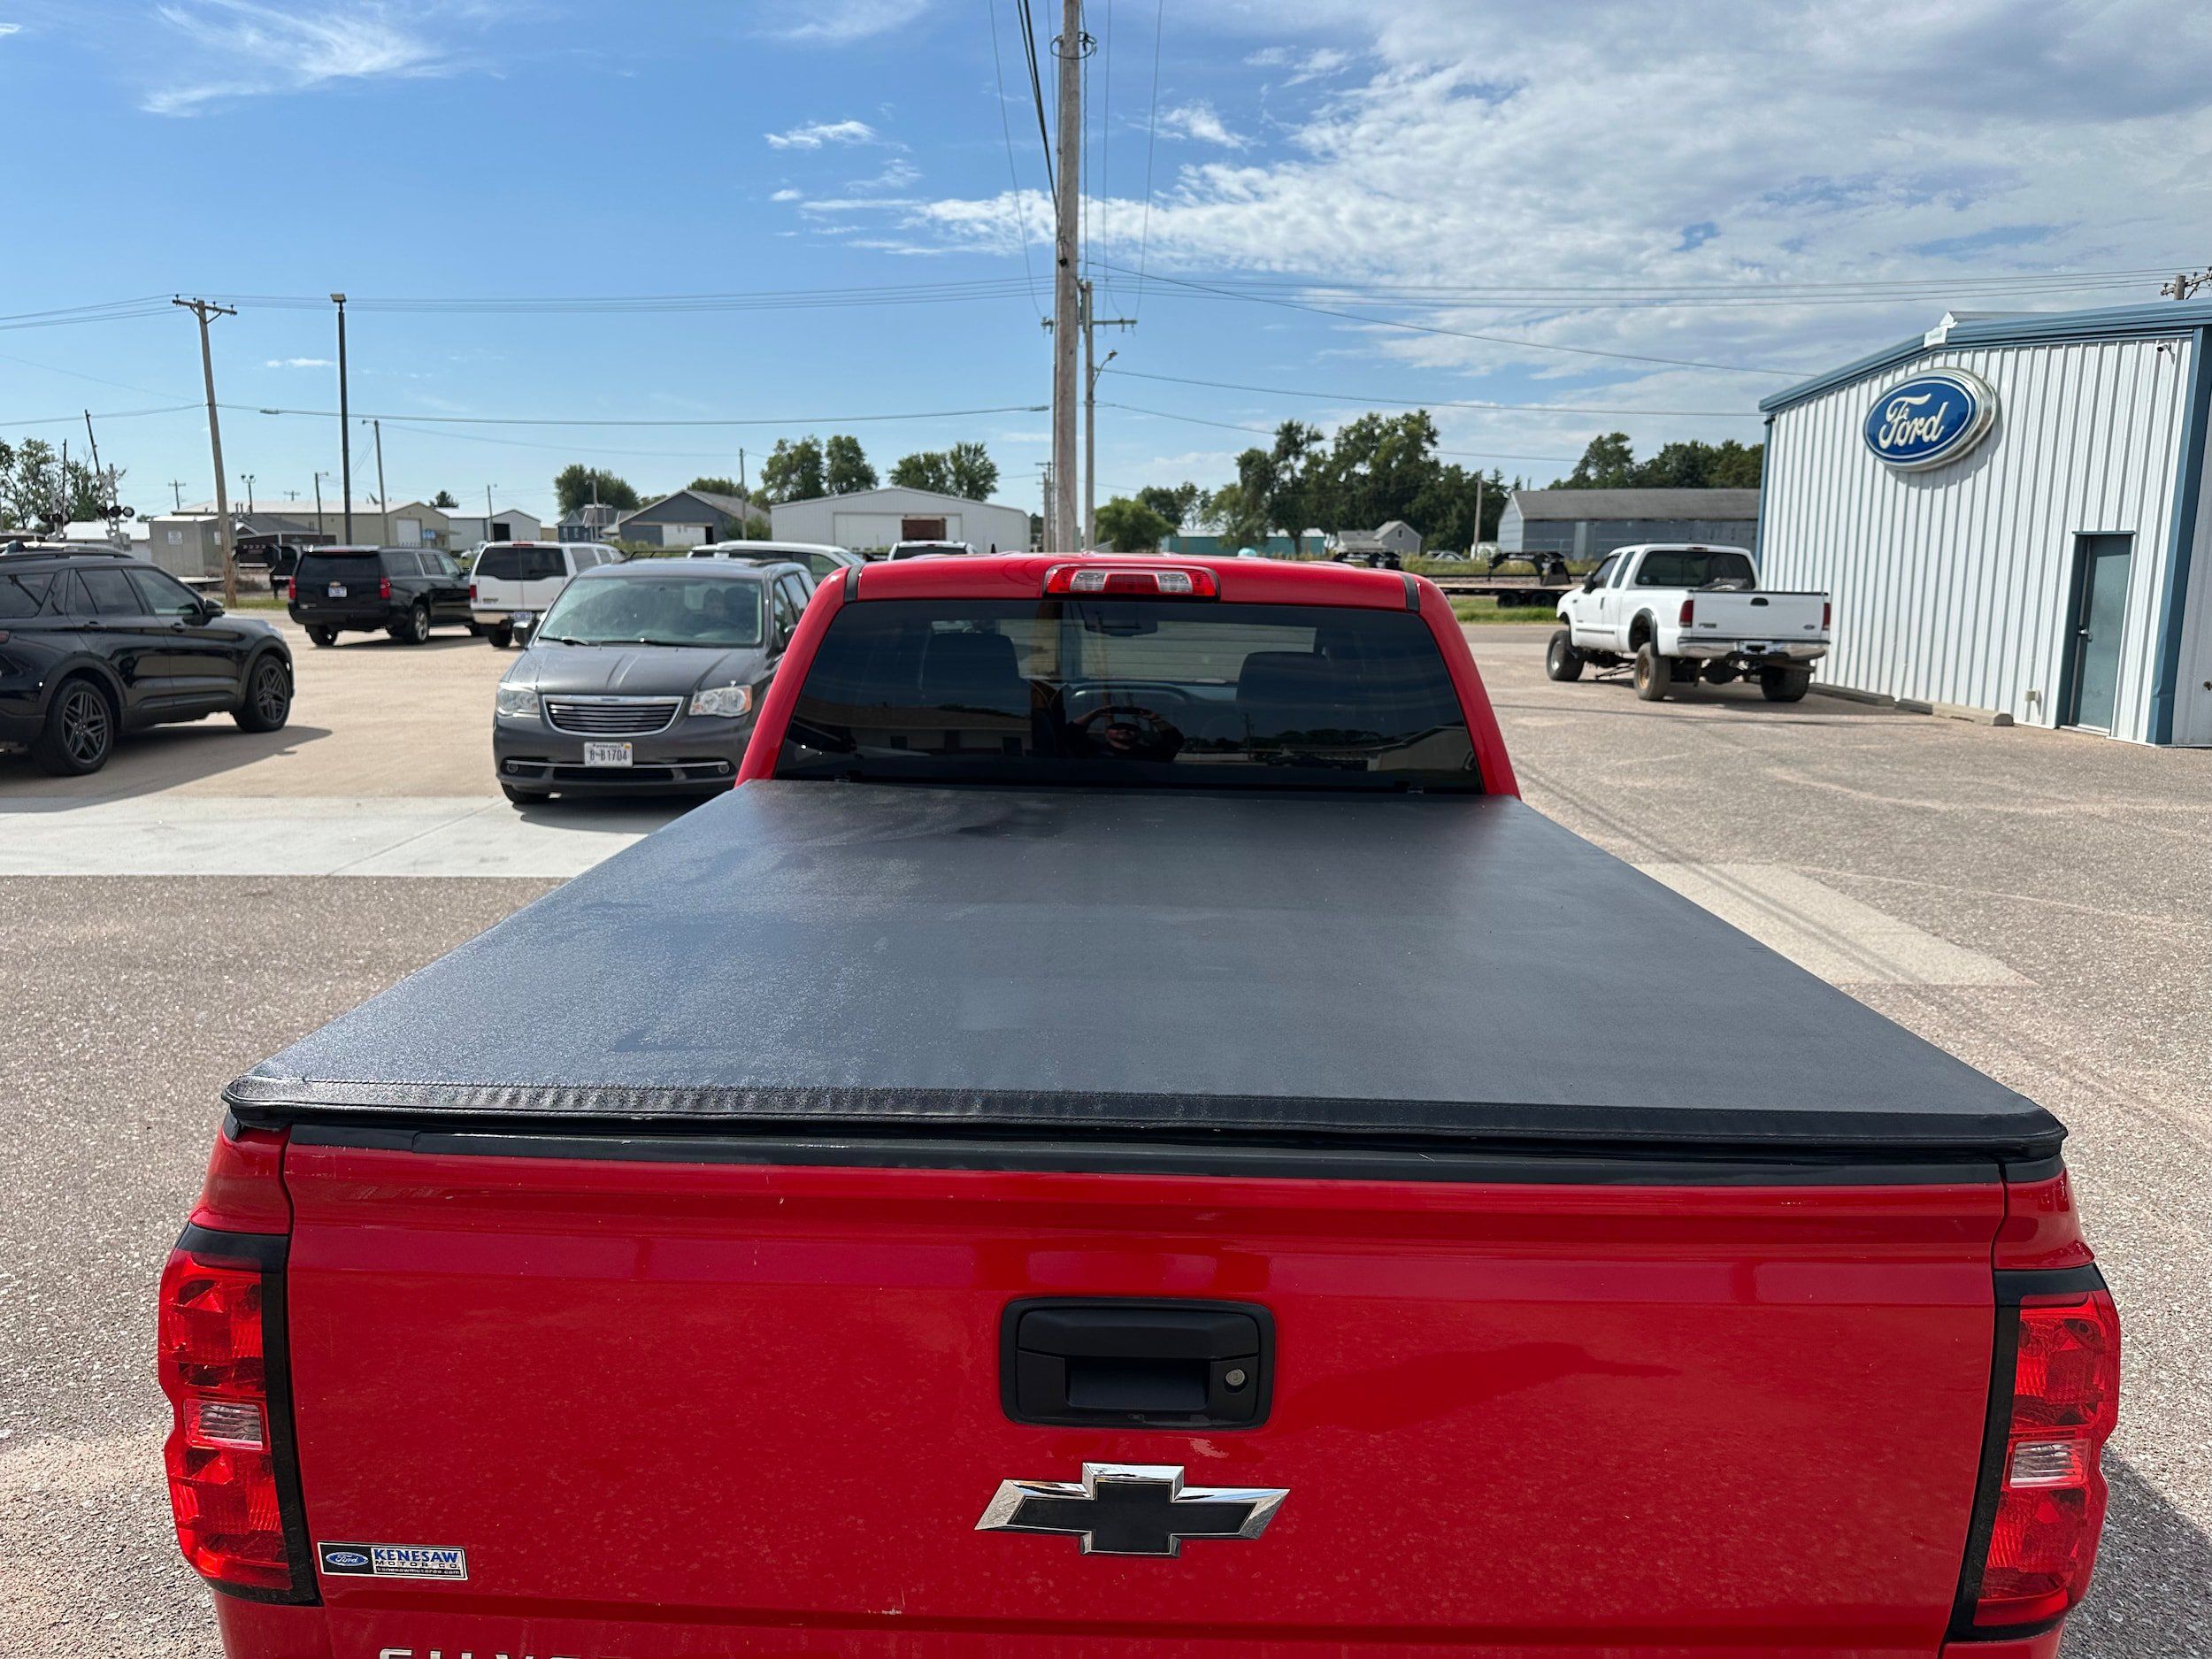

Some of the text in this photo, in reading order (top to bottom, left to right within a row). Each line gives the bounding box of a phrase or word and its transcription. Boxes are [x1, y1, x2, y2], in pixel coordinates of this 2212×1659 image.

[1878, 393, 1948, 449] Ford
[335, 1554, 359, 1563] Ford
[373, 1548, 458, 1563] KENESAW
